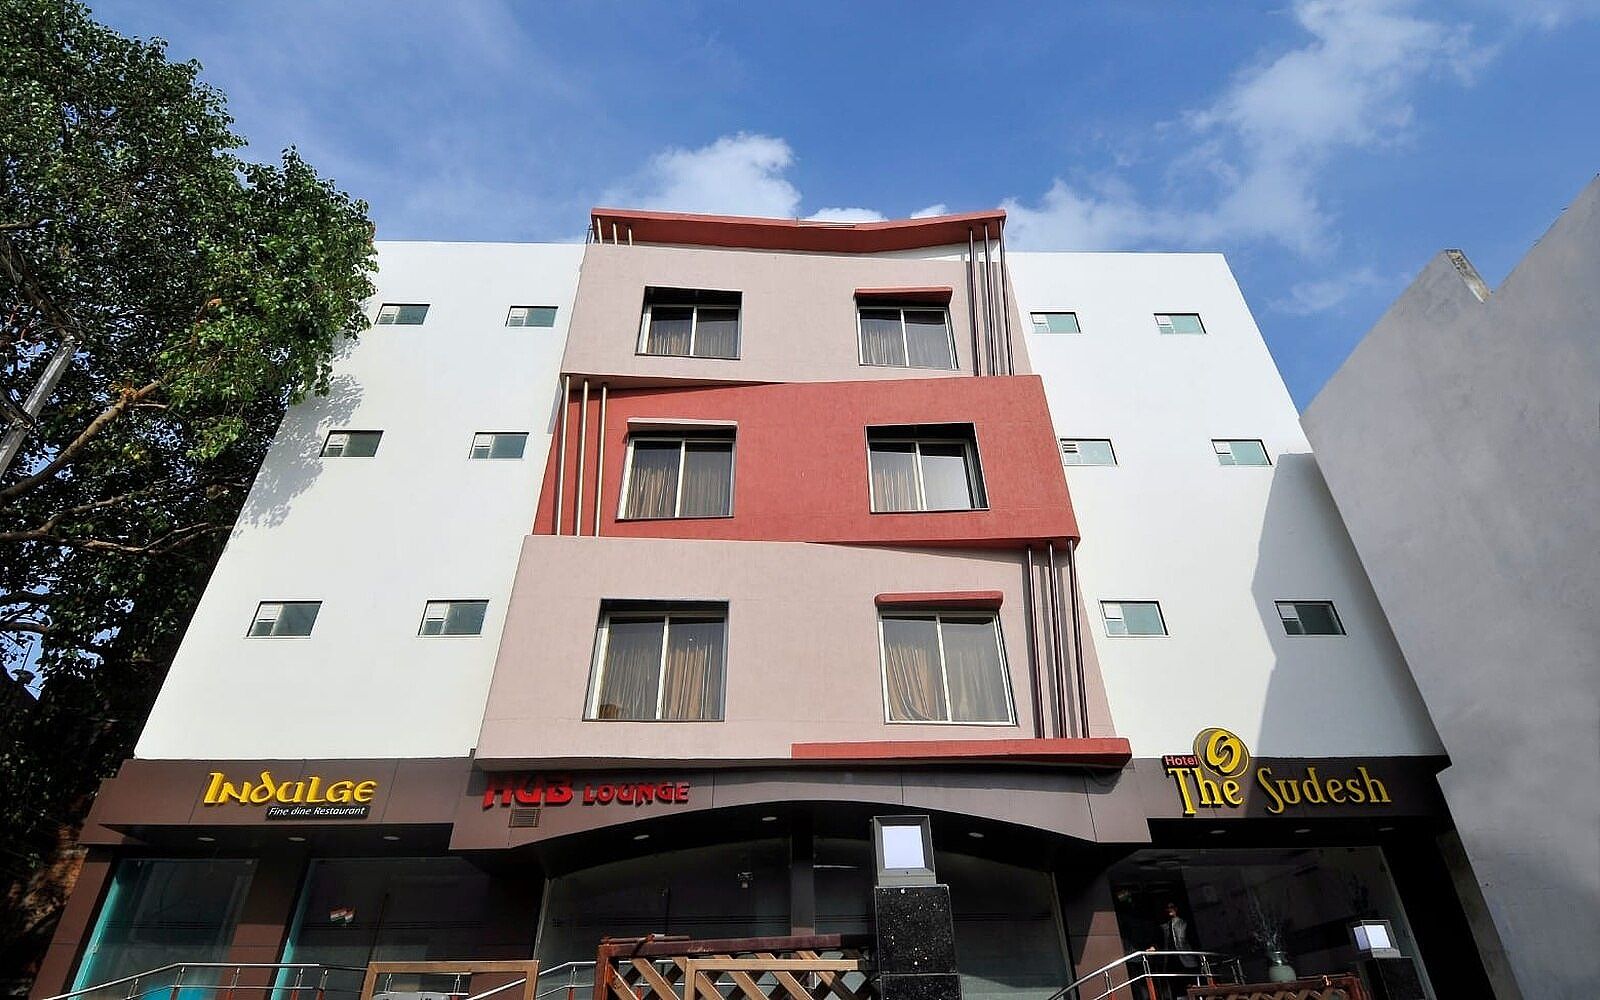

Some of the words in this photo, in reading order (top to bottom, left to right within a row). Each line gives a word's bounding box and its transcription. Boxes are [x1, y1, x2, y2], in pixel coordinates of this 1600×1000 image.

[1165, 755, 1199, 767] Hotel
[582, 781, 690, 806] LOUNGE
[1168, 767, 1243, 815] The
[1257, 766, 1392, 814] Sudesh
[268, 807, 289, 816] Fine
[290, 806, 311, 815] dine
[313, 806, 365, 816] Restaurant
